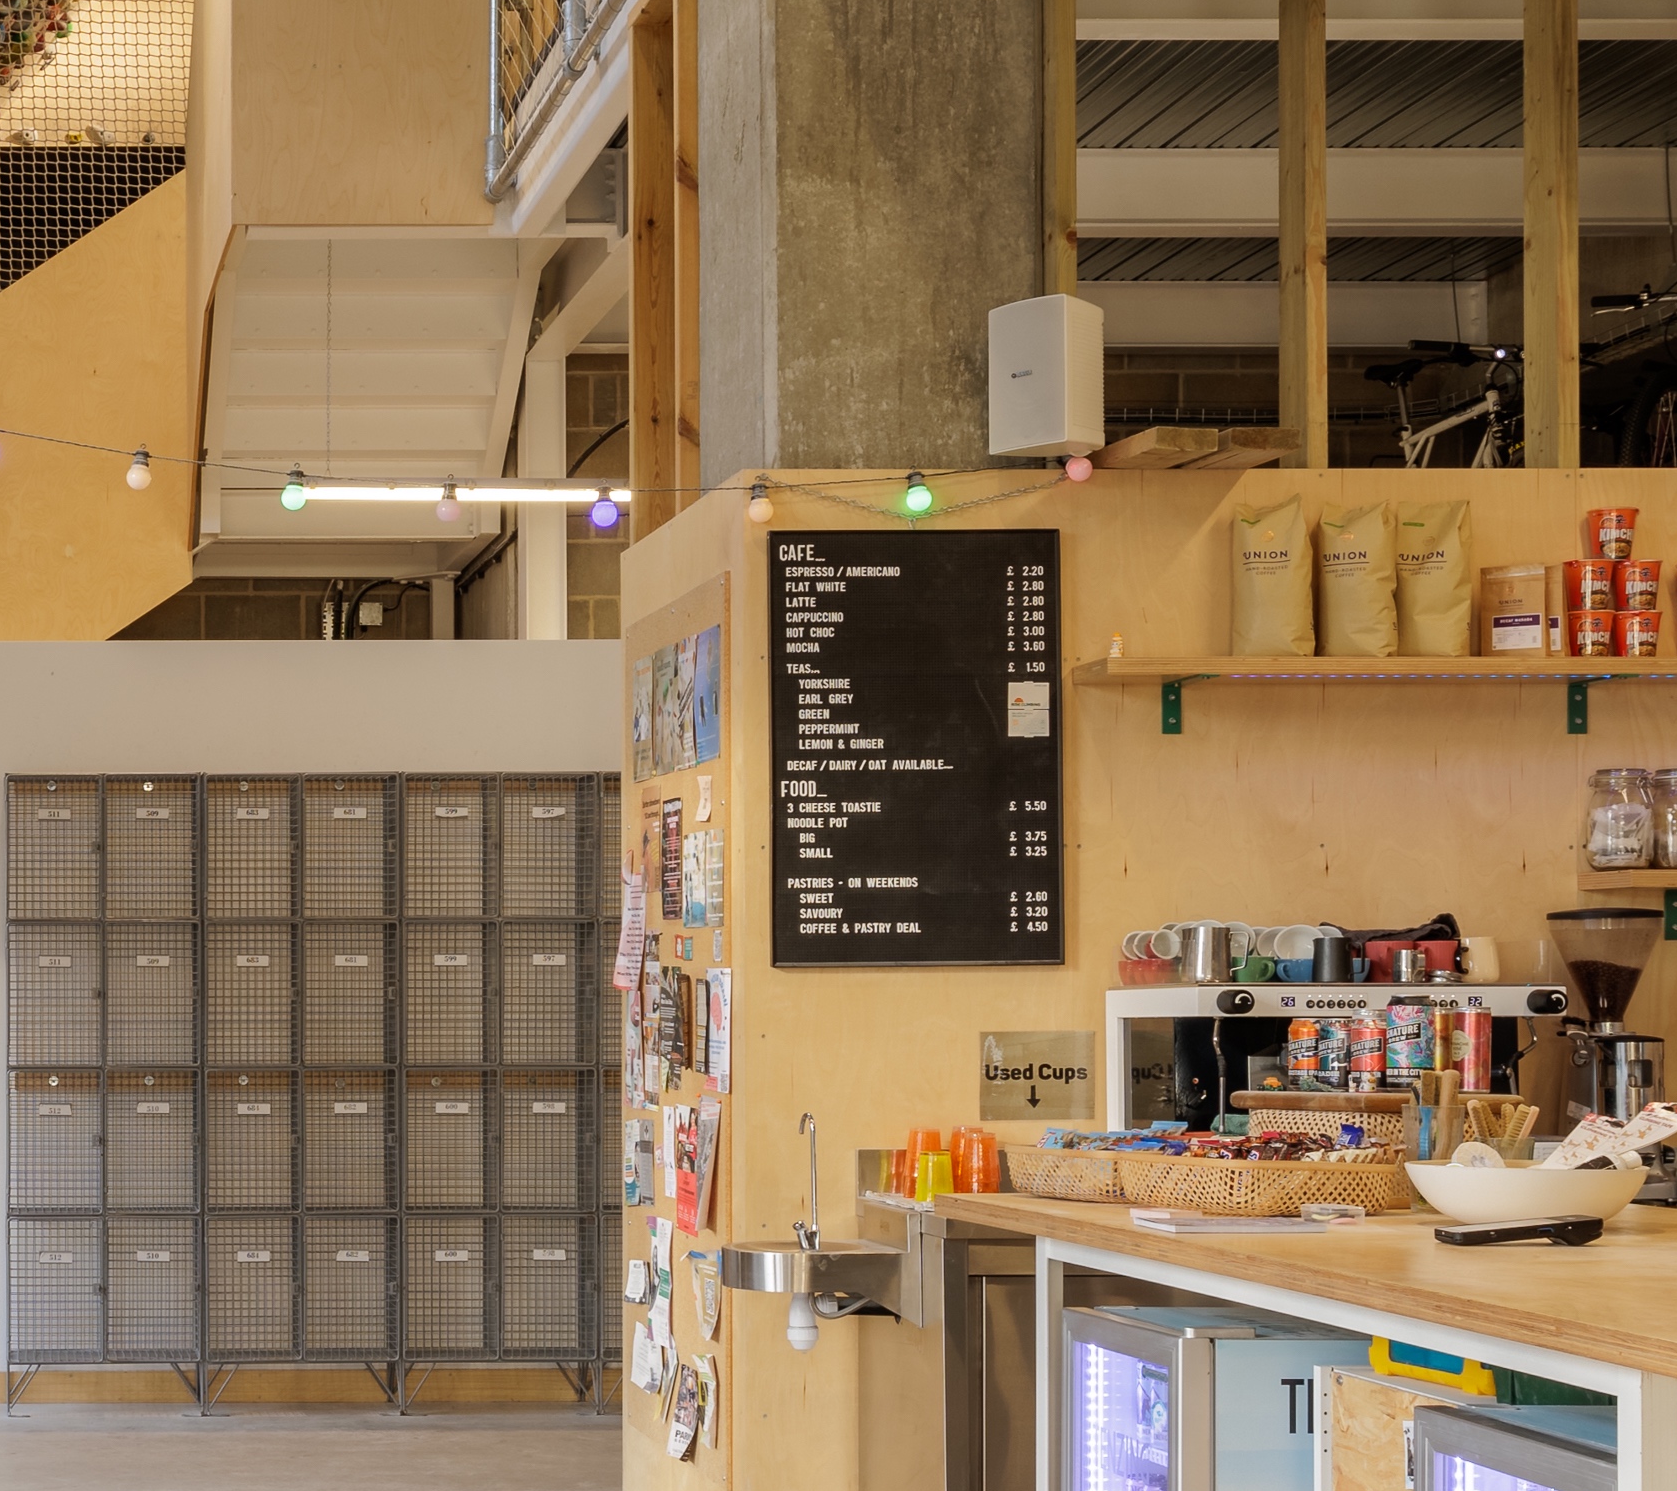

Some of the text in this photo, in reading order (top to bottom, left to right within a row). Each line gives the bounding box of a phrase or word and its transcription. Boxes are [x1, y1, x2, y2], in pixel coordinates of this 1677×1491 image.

[1243, 550, 1288, 560] UNION
[1323, 551, 1367, 562] UNION
[1398, 550, 1444, 561] UNION
[786, 566, 1044, 577] ESPRESSO AMERICANO £ 2.20
[786, 581, 1044, 591] FLAT WHITE £ 2.80
[786, 597, 1044, 607] LATTE £ 2.80
[786, 611, 1044, 623] CAPPUCCINO £ 2.80
[786, 627, 1045, 637] HOT CHOC £ 3.00
[786, 641, 1045, 653] MOCHA £ 3.60
[1008, 663, 1015, 672] £
[1026, 663, 1045, 672] 1.50
[799, 679, 850, 689] YORKSHIRE
[799, 694, 853, 703] EARL GREY
[799, 709, 829, 719] GREEN
[799, 724, 859, 734] PEPPERMINT
[799, 739, 884, 749] LEMON & GINGER
[787, 761, 817, 771] DECAF
[829, 761, 857, 770] DAIRY
[869, 760, 886, 770] OAT
[787, 801, 1047, 813] 3 CHEESE TOASTIE £ 5.50
[787, 818, 848, 828] NOODLE POT
[800, 831, 1047, 843] BIG £ 3.75
[800, 847, 1047, 858] SMALL £ 3.25
[788, 877, 918, 888] PASTRIES ON WEEKENDS
[800, 892, 1047, 903] SWEET £ 2.60
[800, 907, 1048, 919] SAVOURY £ 3.20
[800, 922, 1048, 933] COFFEE & PASTRY DEAL £ 4.50
[1282, 997, 1295, 1006] 26
[985, 1064, 1088, 1084] Used Cups
